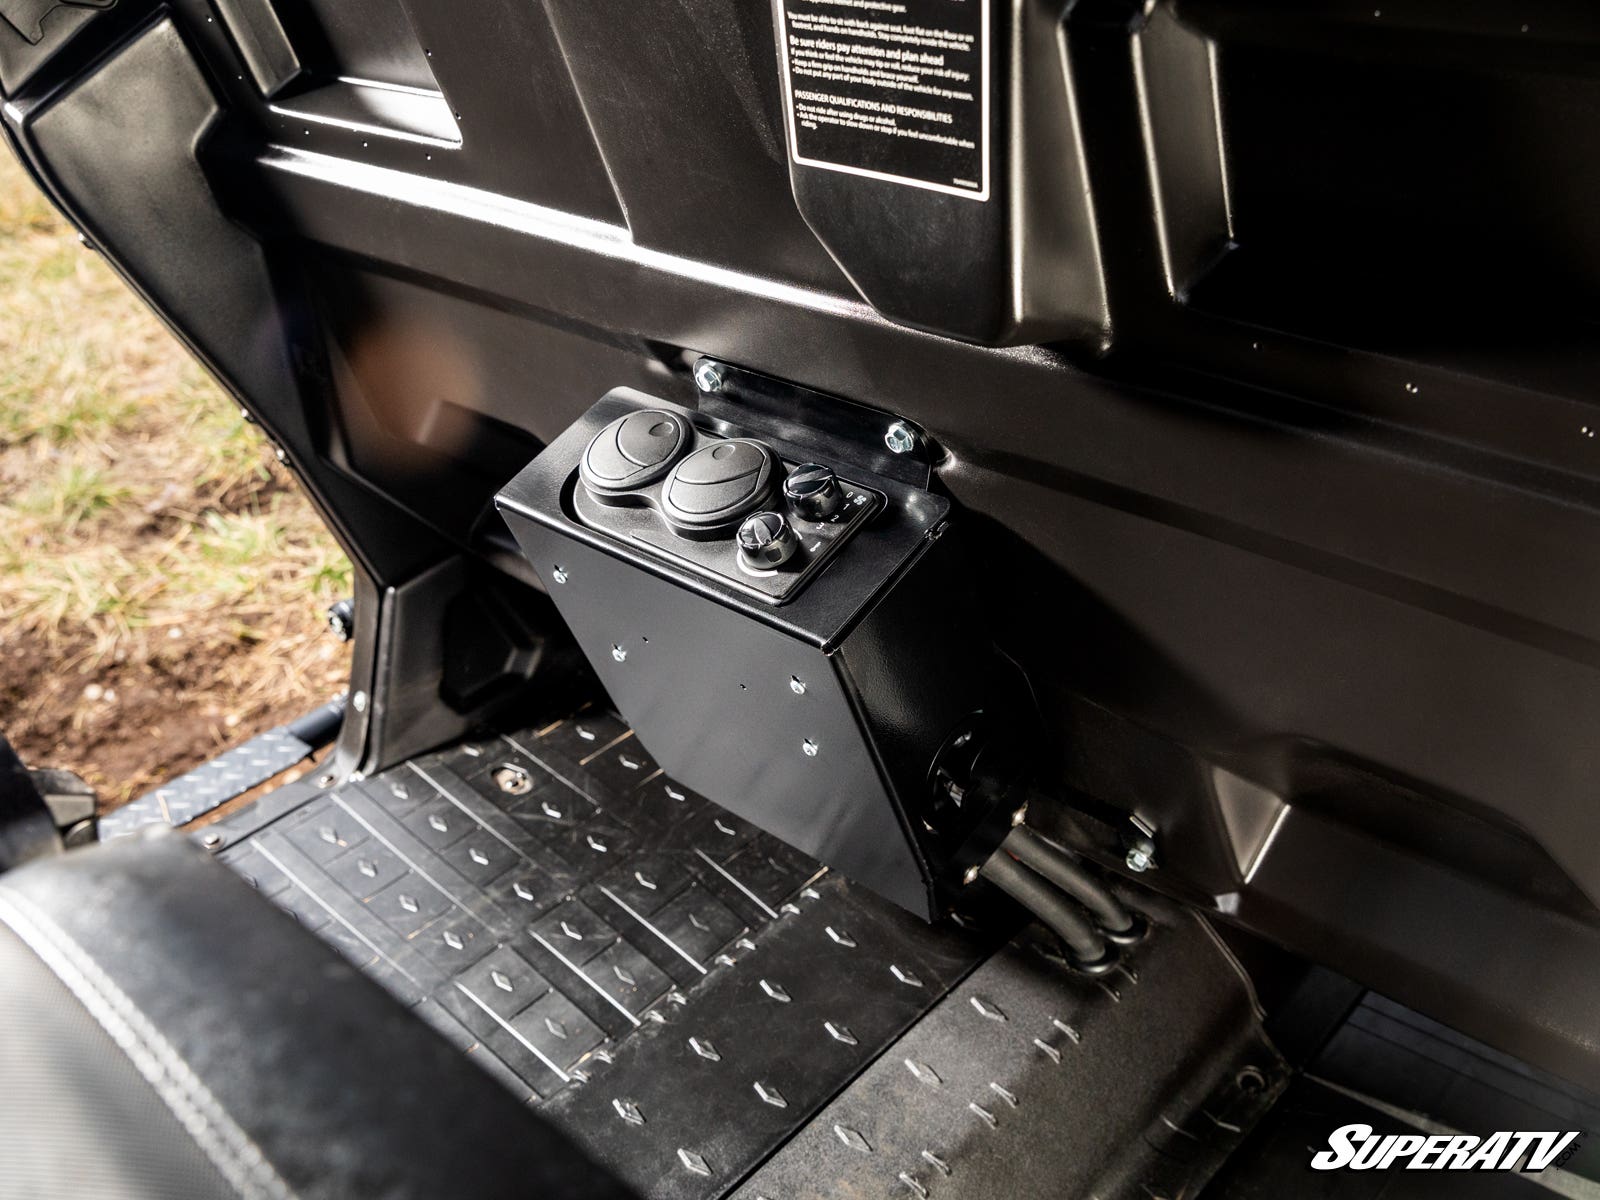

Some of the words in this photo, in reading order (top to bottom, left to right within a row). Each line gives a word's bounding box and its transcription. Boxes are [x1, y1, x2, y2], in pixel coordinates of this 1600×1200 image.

[789, 34, 799, 46] Be
[800, 38, 815, 48] sure
[815, 38, 836, 51] riders
[837, 43, 851, 55] pay
[851, 44, 885, 58] attention
[886, 48, 901, 60] and
[901, 50, 919, 63] plan
[920, 52, 944, 66] ahead
[794, 89, 829, 103] PASSENGER
[829, 95, 880, 112] QUALIFICATIONS
[881, 103, 896, 114] AND
[896, 105, 953, 124] RESPONSIBILITIES
